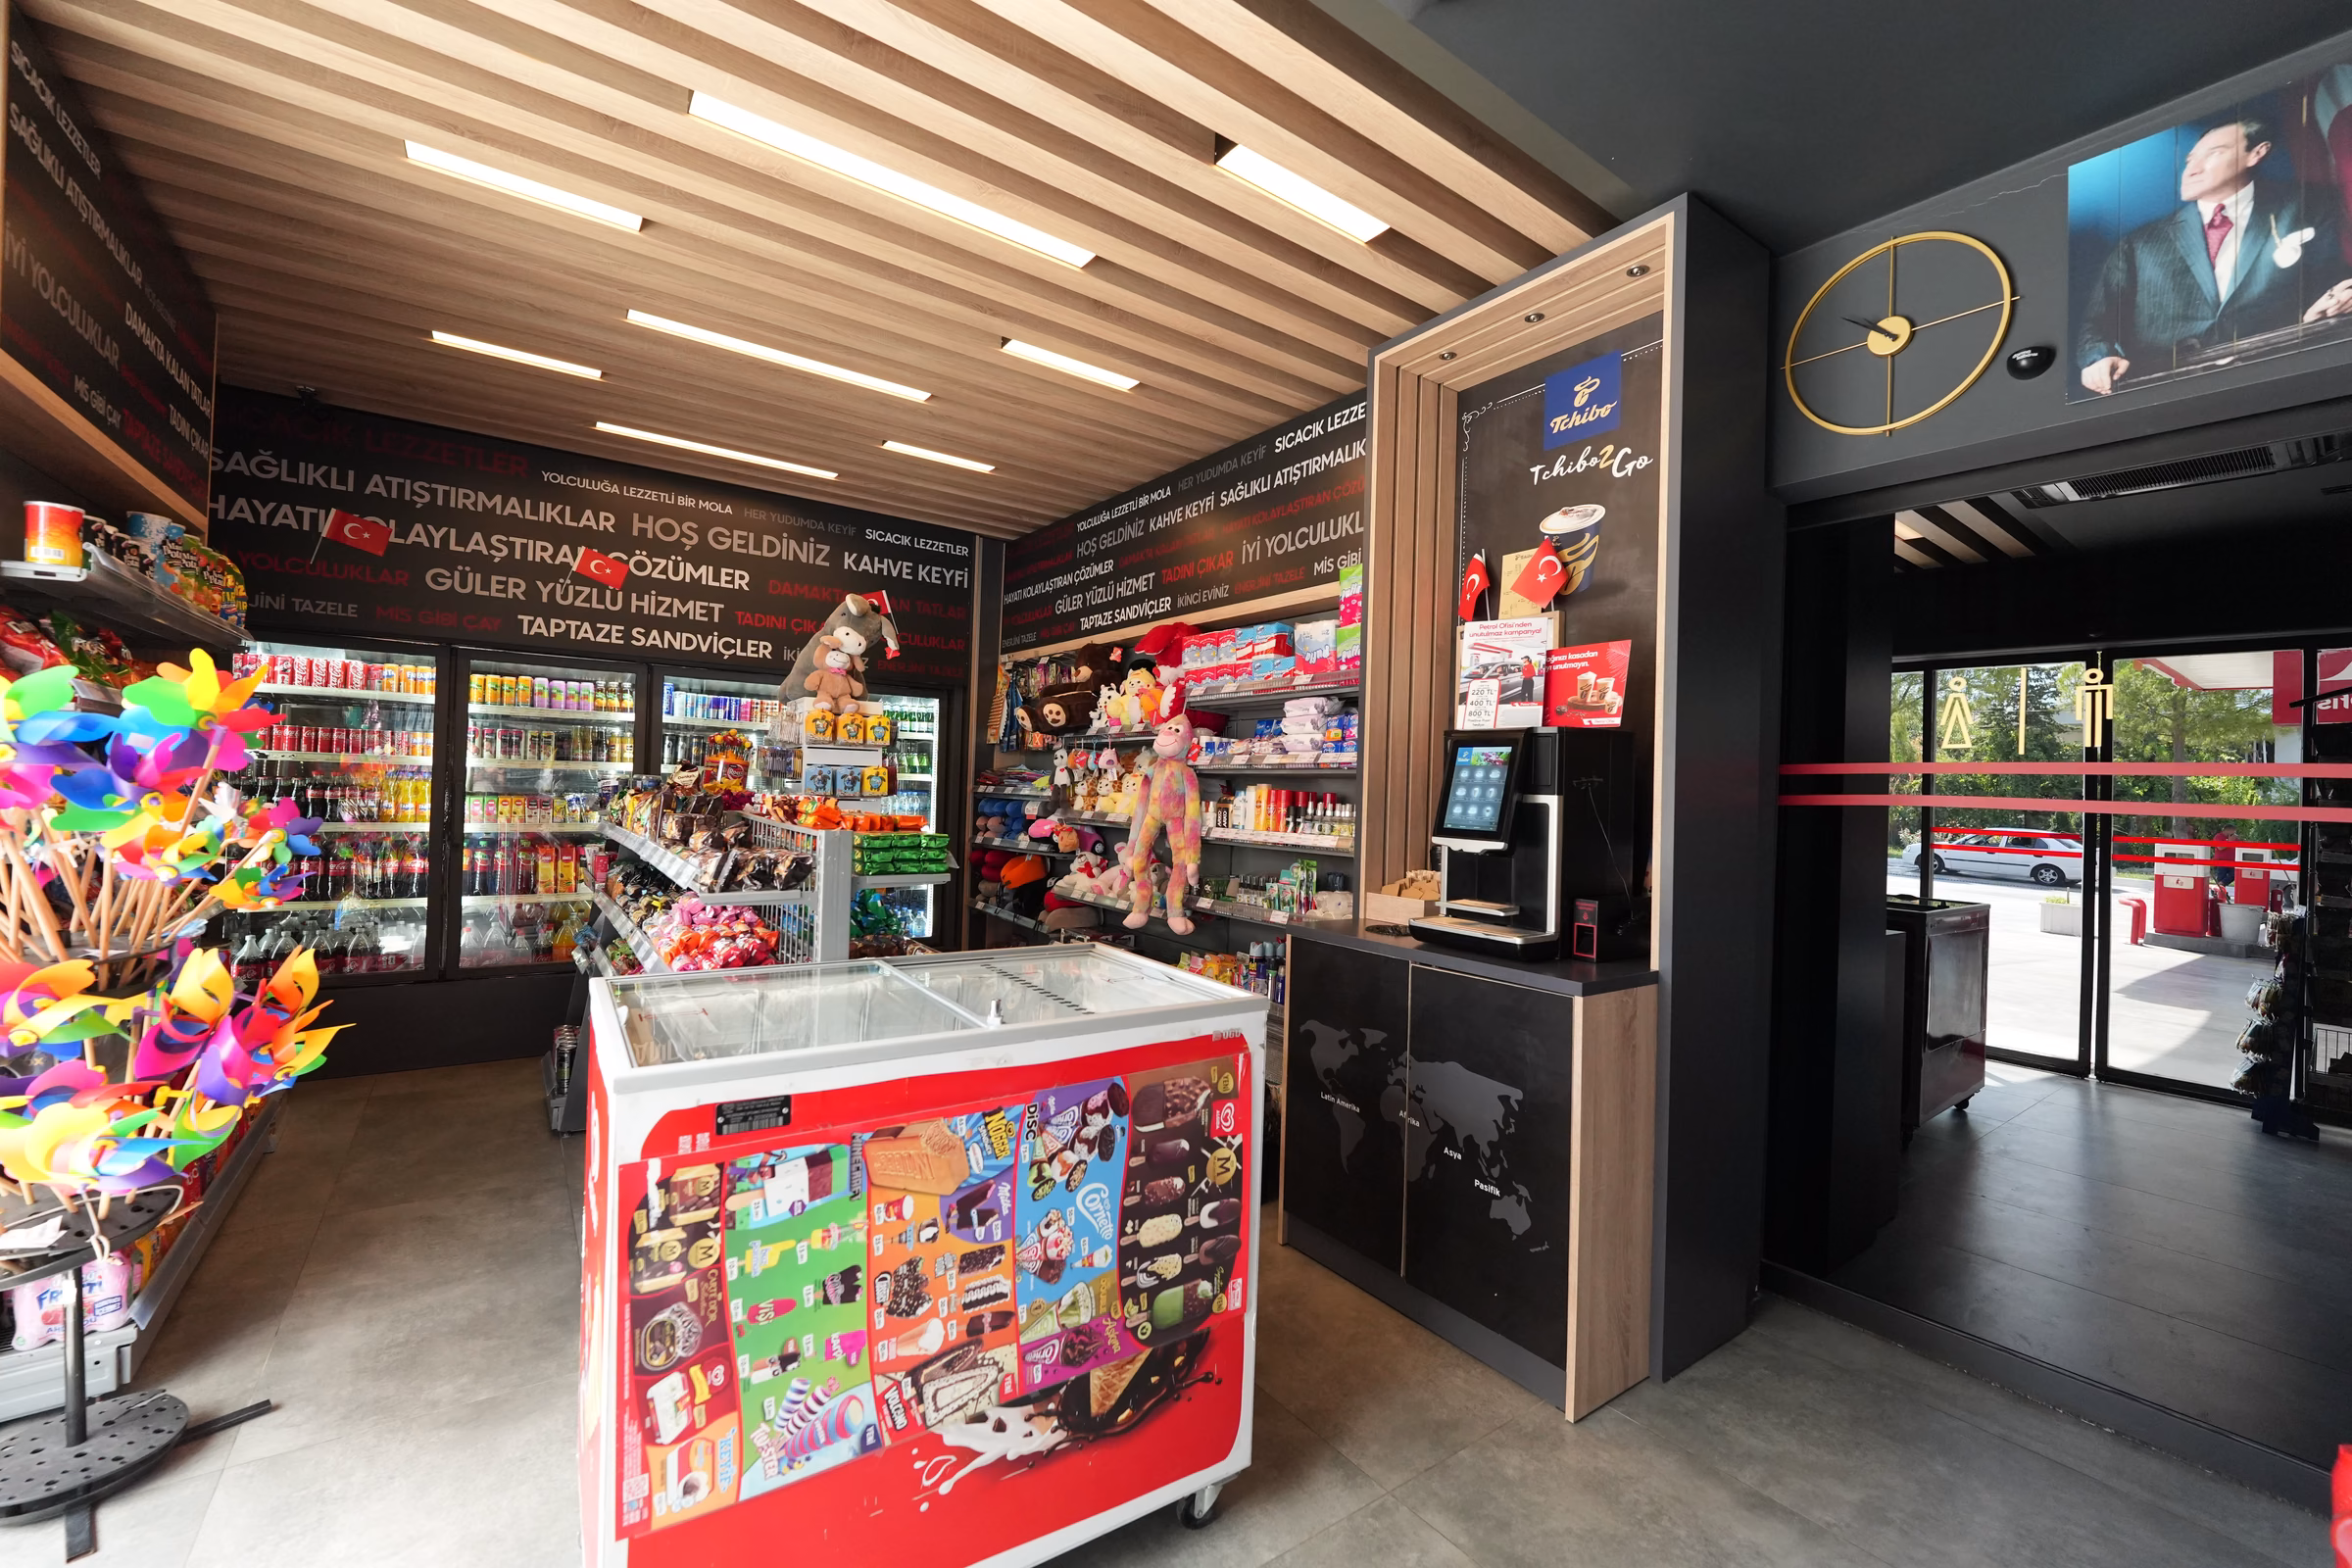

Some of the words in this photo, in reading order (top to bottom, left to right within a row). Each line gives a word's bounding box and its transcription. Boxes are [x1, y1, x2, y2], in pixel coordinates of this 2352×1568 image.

[12, 40, 56, 117] SICACIK
[57, 103, 101, 179] LEZZETLER
[10, 102, 65, 189] SAĞLIKLI
[66, 176, 143, 289] ATIŞTIRMALIKLAR
[30, 253, 120, 370] YOLCULUKLAR
[125, 302, 165, 366] DAMAKTA
[166, 350, 190, 394] KALAN
[190, 379, 212, 419] TATLAR
[1549, 400, 1618, 434] Tchibo
[1076, 511, 1110, 533] YOLCULUĞA
[1111, 497, 1139, 520] LEZZETLİ
[1139, 494, 1150, 508] BİR
[1151, 486, 1172, 504] MOLA
[1178, 475, 1194, 493] HER
[1196, 458, 1239, 485] YUDUMDA
[1240, 444, 1267, 467] KEYİF
[1274, 419, 1325, 454] SICACIK
[1327, 401, 1367, 433] LEZZE
[1529, 444, 1654, 486] Tchibo2Go
[212, 448, 355, 492] SAĞLIKLI
[365, 473, 616, 533] ATIŞTIRMALIKLAR
[632, 513, 699, 552] HOŞ
[707, 526, 831, 567] GELDİNİZ
[844, 551, 913, 580] KAHVE
[918, 563, 969, 589] KEYFİ
[541, 470, 620, 495] YOLCULUĞA
[623, 486, 675, 505] LEZZETLİ
[677, 494, 697, 509] BİR
[699, 499, 733, 515] MOLA
[744, 507, 767, 521] HER
[769, 512, 825, 532] YUDUMDA
[828, 522, 857, 537] KEYİF
[865, 528, 911, 547] SICACIK
[914, 537, 969, 557] LEZZETLER
[1076, 538, 1098, 559] HOŞ
[1099, 517, 1145, 550] GELDİNİZ
[1149, 506, 1184, 533] KAHVE
[1185, 491, 1215, 520] KEYFİ
[1219, 474, 1271, 508] SAĞLIKLI
[1273, 437, 1367, 490] ATIŞTIRMALIK
[351, 514, 599, 566] LAYLAŞTIRA
[1004, 589, 1023, 606] HAYATI
[1022, 574, 1073, 598] KOLAYLAŞTIRAN
[1074, 559, 1114, 585] ÇÖZÜMLER
[1332, 474, 1365, 504] ÇÖZÜ
[1055, 592, 1083, 615] GÜLER
[1085, 582, 1114, 607] YÜZLÜ
[1116, 572, 1155, 599] HİZMET
[1161, 561, 1195, 585] TADINI
[1198, 550, 1234, 578] ÇIKAR
[1242, 535, 1260, 564] İYİ
[1264, 511, 1364, 558] YOLCULUKL
[425, 564, 527, 601] GÜLER
[535, 578, 623, 612] YÜZLÜ
[630, 590, 725, 623] HİZMET
[734, 611, 787, 630] TADINI
[791, 617, 825, 637] ÇIK
[1080, 610, 1113, 631] TAPTAZE
[1113, 596, 1172, 623] SANDVİÇLER
[1177, 588, 1201, 609] İKİNCİ
[1202, 584, 1230, 604] EVİNİZ
[1313, 556, 1335, 576] MİS
[1337, 547, 1363, 569] GİBİ
[249, 592, 285, 611] JİNİ
[291, 598, 359, 618] TAZELE
[517, 614, 625, 645] TAPTAZE
[630, 627, 773, 661] SANDVİÇLER
[1503, 627, 1543, 637] kampanya!
[1568, 651, 1598, 660] kasadan
[1320, 1091, 1336, 1103] Latin
[1336, 1097, 1360, 1113] Amerika
[1398, 1109, 1420, 1127] Afrika
[985, 1110, 1010, 1160] NOGGER
[1444, 1146, 1462, 1160] Asya
[849, 1131, 864, 1201] MINECRAFT
[1474, 1178, 1501, 1198] Pasifik
[998, 1182, 1011, 1217] Milka
[1076, 1182, 1115, 1241] Cornetto
[884, 1386, 908, 1431] VOLCANO
[1004, 1374, 1013, 1395] YENİ
[865, 1425, 876, 1446] YENİ
